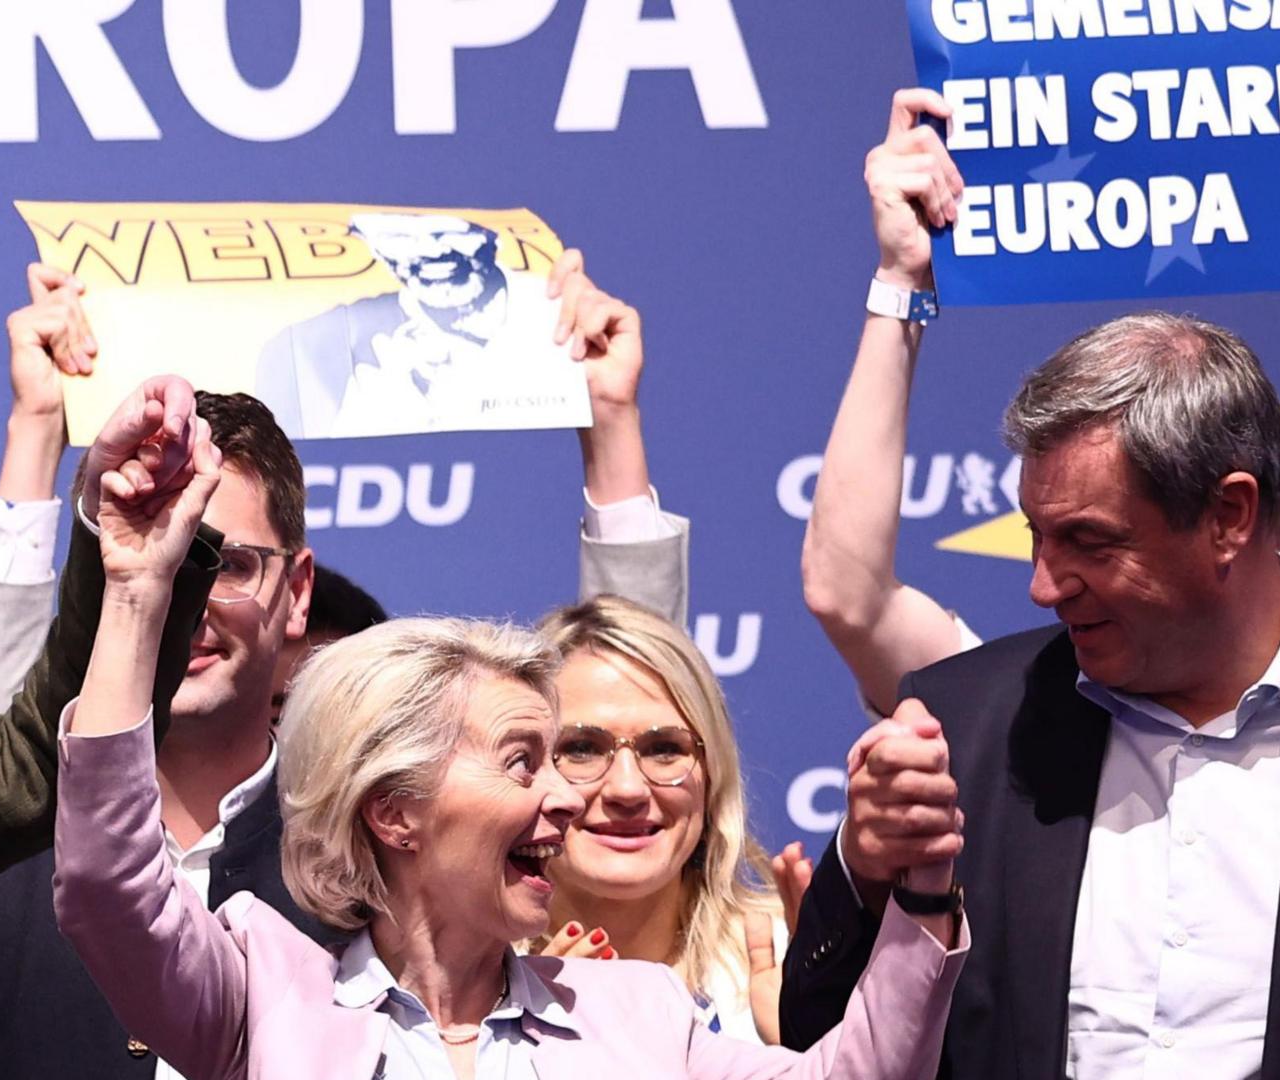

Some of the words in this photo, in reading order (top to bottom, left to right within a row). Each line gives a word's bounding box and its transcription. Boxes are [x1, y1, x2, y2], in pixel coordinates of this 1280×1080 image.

[942, 74, 1070, 150] EIN
[953, 172, 1250, 257] EUROPA
[776, 453, 955, 521] CU
